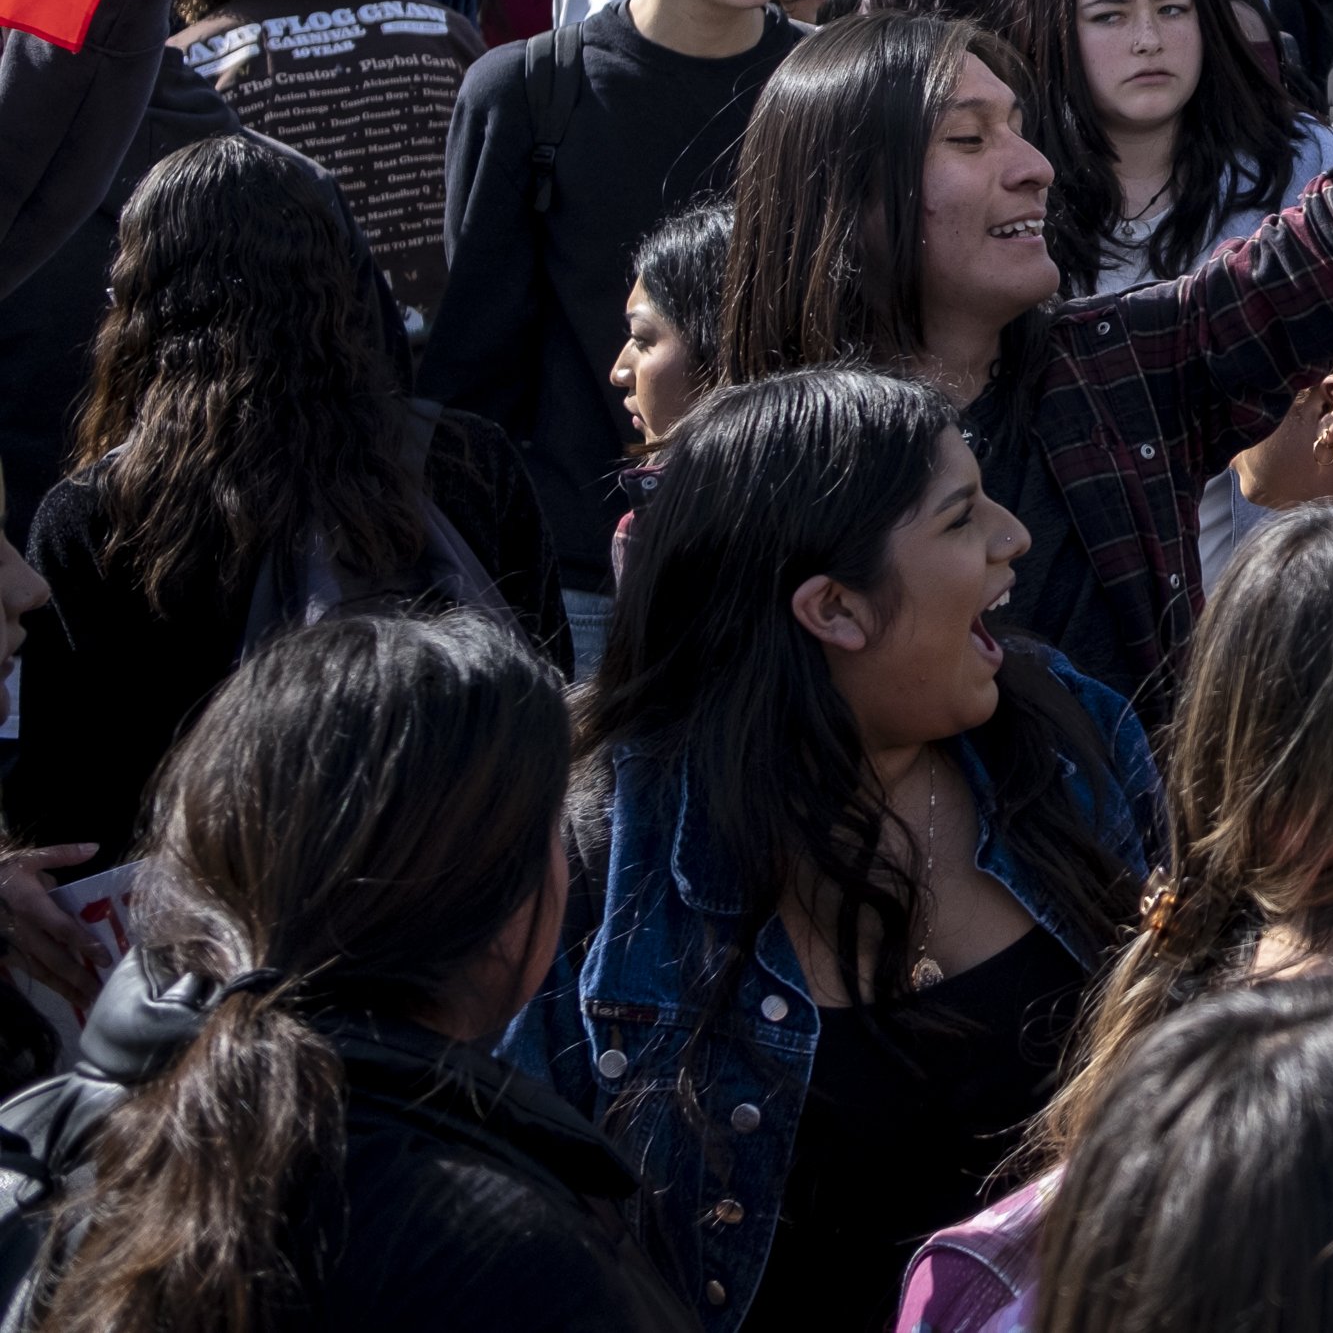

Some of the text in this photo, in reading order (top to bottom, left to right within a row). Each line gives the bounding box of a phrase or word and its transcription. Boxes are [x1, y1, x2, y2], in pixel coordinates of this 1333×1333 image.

[184, 23, 262, 66] AMP
[262, 7, 358, 37] FLOG
[356, 0, 447, 24] GNAW
[267, 24, 367, 51] CARNIVAL
[239, 77, 272, 97] The
[275, 68, 337, 85] Creator
